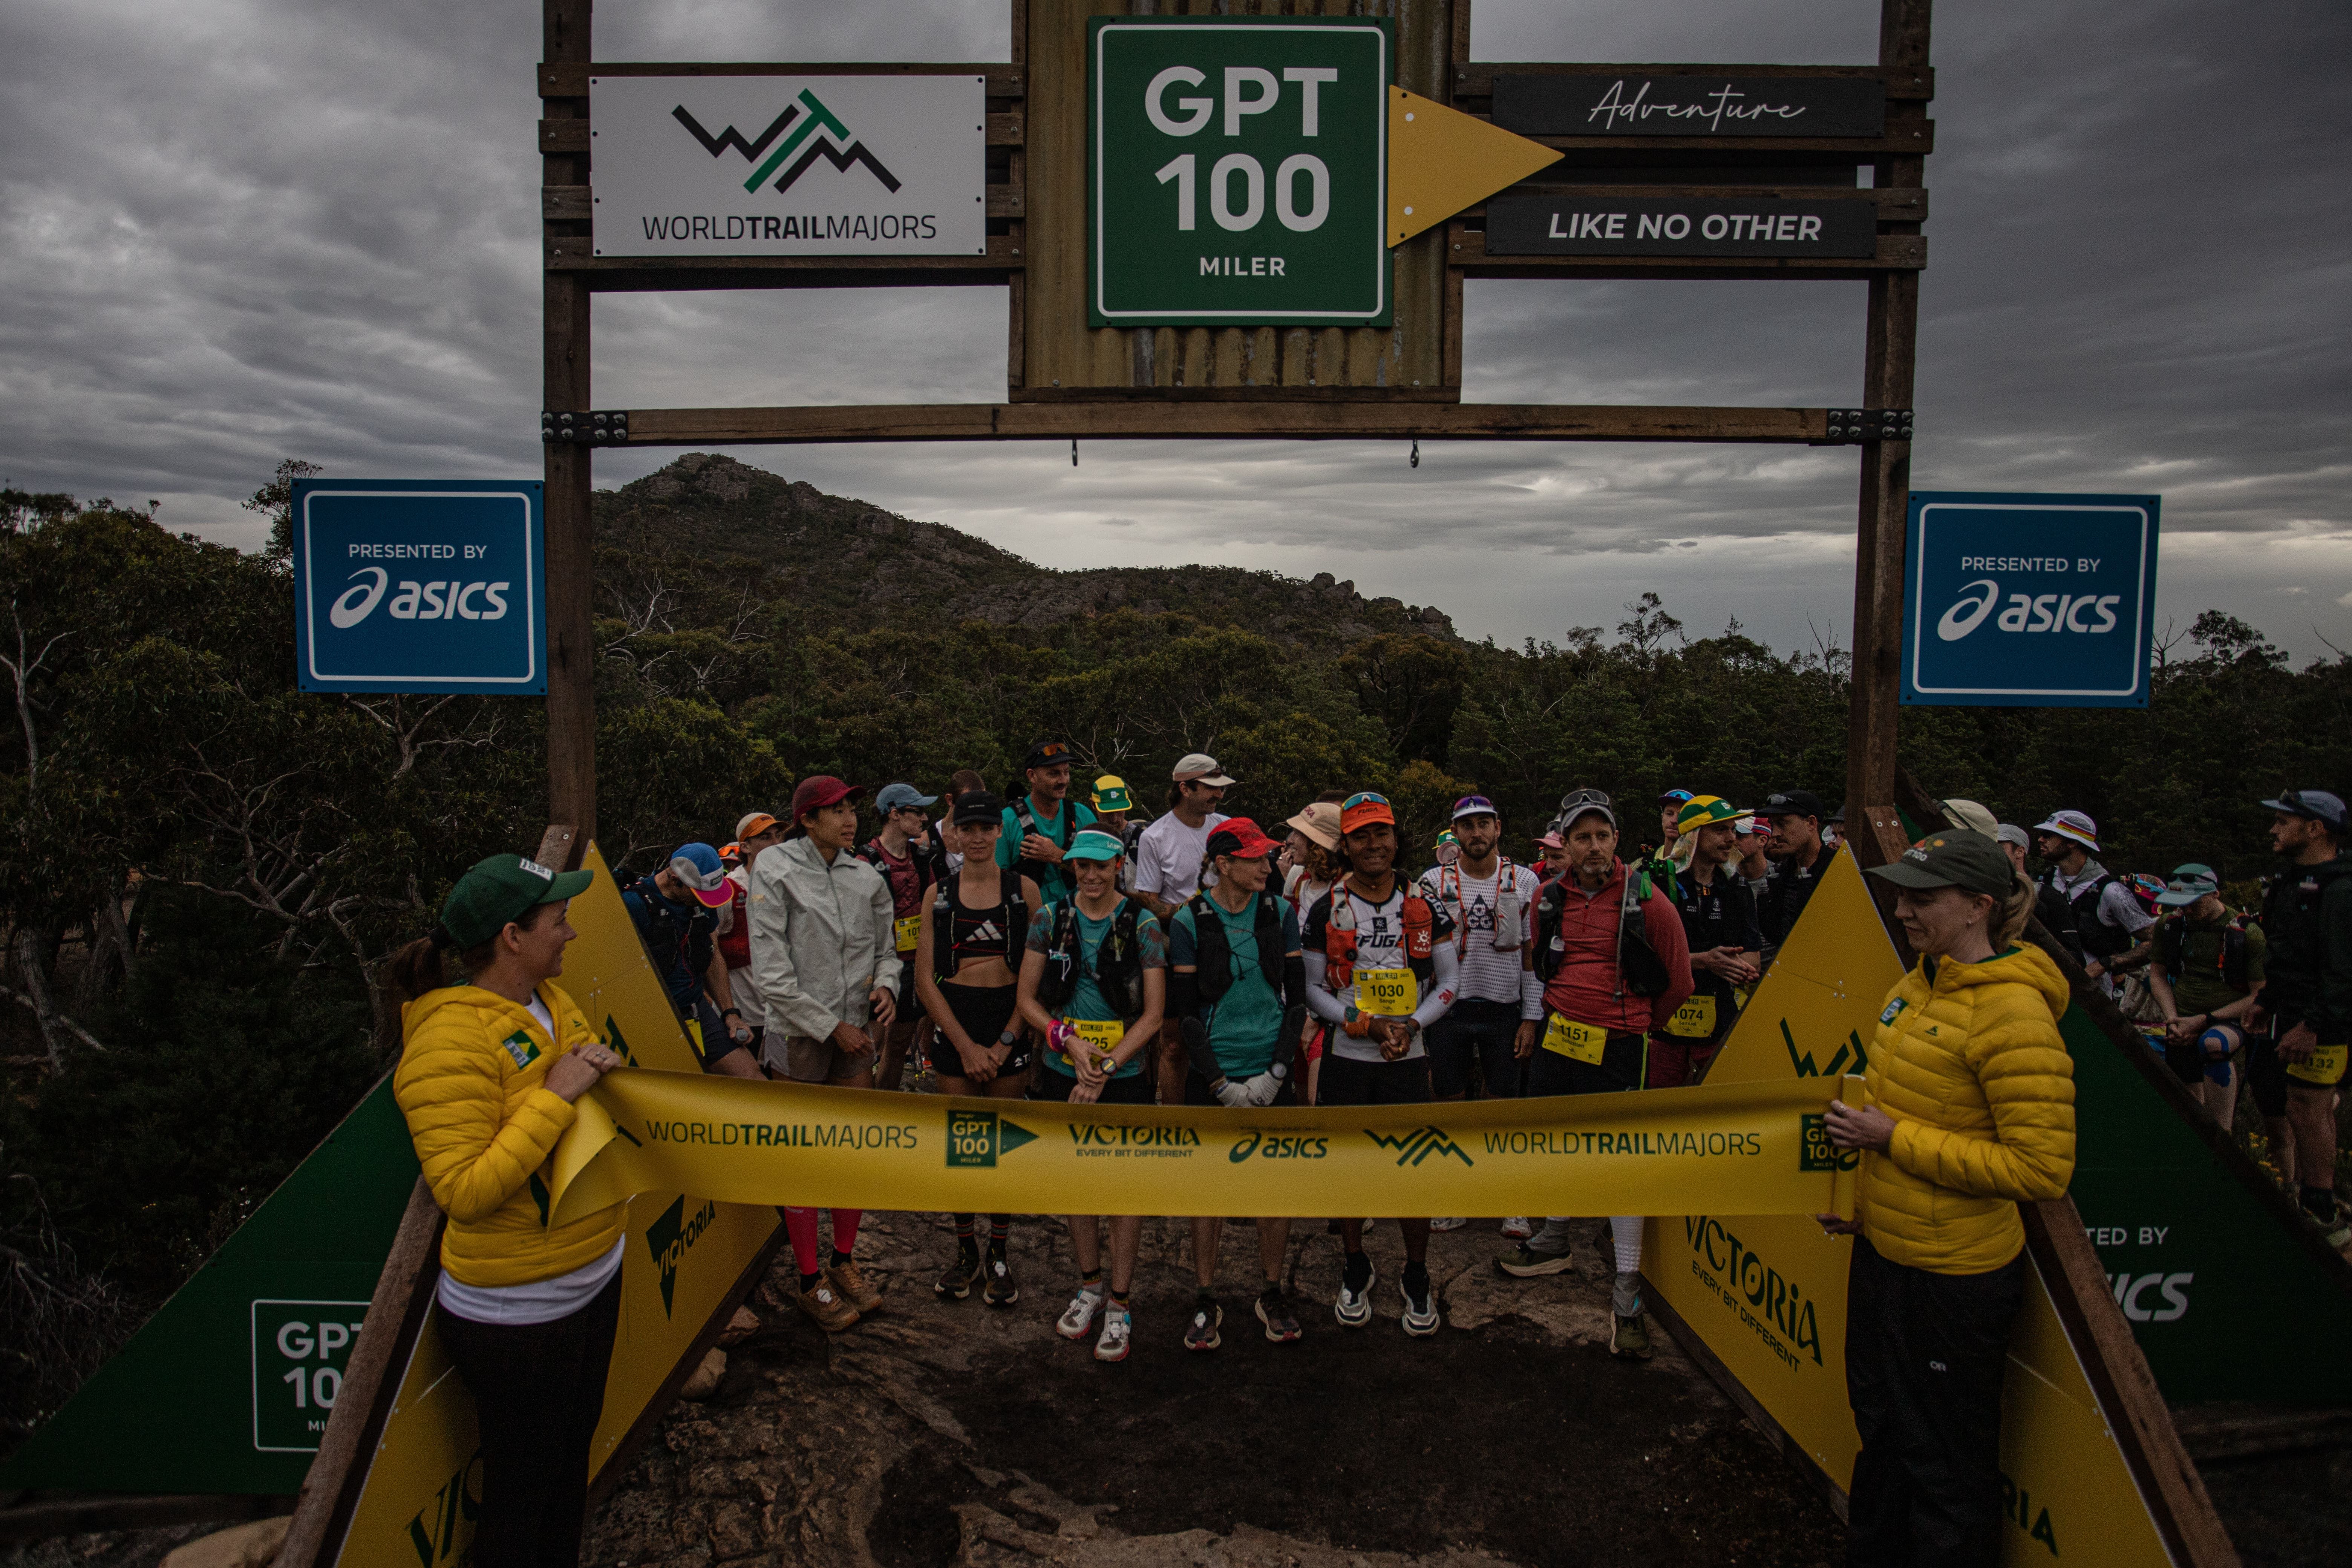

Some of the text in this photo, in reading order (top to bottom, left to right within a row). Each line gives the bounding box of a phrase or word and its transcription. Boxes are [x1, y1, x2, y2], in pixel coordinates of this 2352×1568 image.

[1145, 66, 1337, 137] GPT
[1588, 80, 1806, 132] Adventure
[1154, 153, 1330, 232] 100
[642, 215, 937, 241] WORLDTRAILMAJORS
[1549, 213, 1822, 242] LIKE NO OTHER
[1199, 257, 1285, 276] MILER
[349, 544, 487, 559] PRESENTED BY
[1962, 557, 2101, 572] PRESENTED BY
[1370, 985, 1404, 997] 1030
[1438, 989, 1454, 1006] 3M
[1673, 1008, 1704, 1021] 1074
[1559, 1024, 1589, 1043] 1151
[1561, 1037, 1585, 1049] Sebastian
[646, 1120, 917, 1150] WORLDTRAILMAJORS
[952, 1121, 991, 1136] GPT
[1069, 1123, 1202, 1147] VICTORIA
[952, 1138, 990, 1155] 100
[1076, 1148, 1193, 1158] EVERY BIT DIFFERENT
[1484, 1132, 1761, 1156] WORLDTRAILMAJORS
[2138, 1227, 2170, 1245] BY
[1685, 1216, 1823, 1367] VICTORIA
[1692, 1260, 1800, 1372] EVERY BIT DIFFERENT
